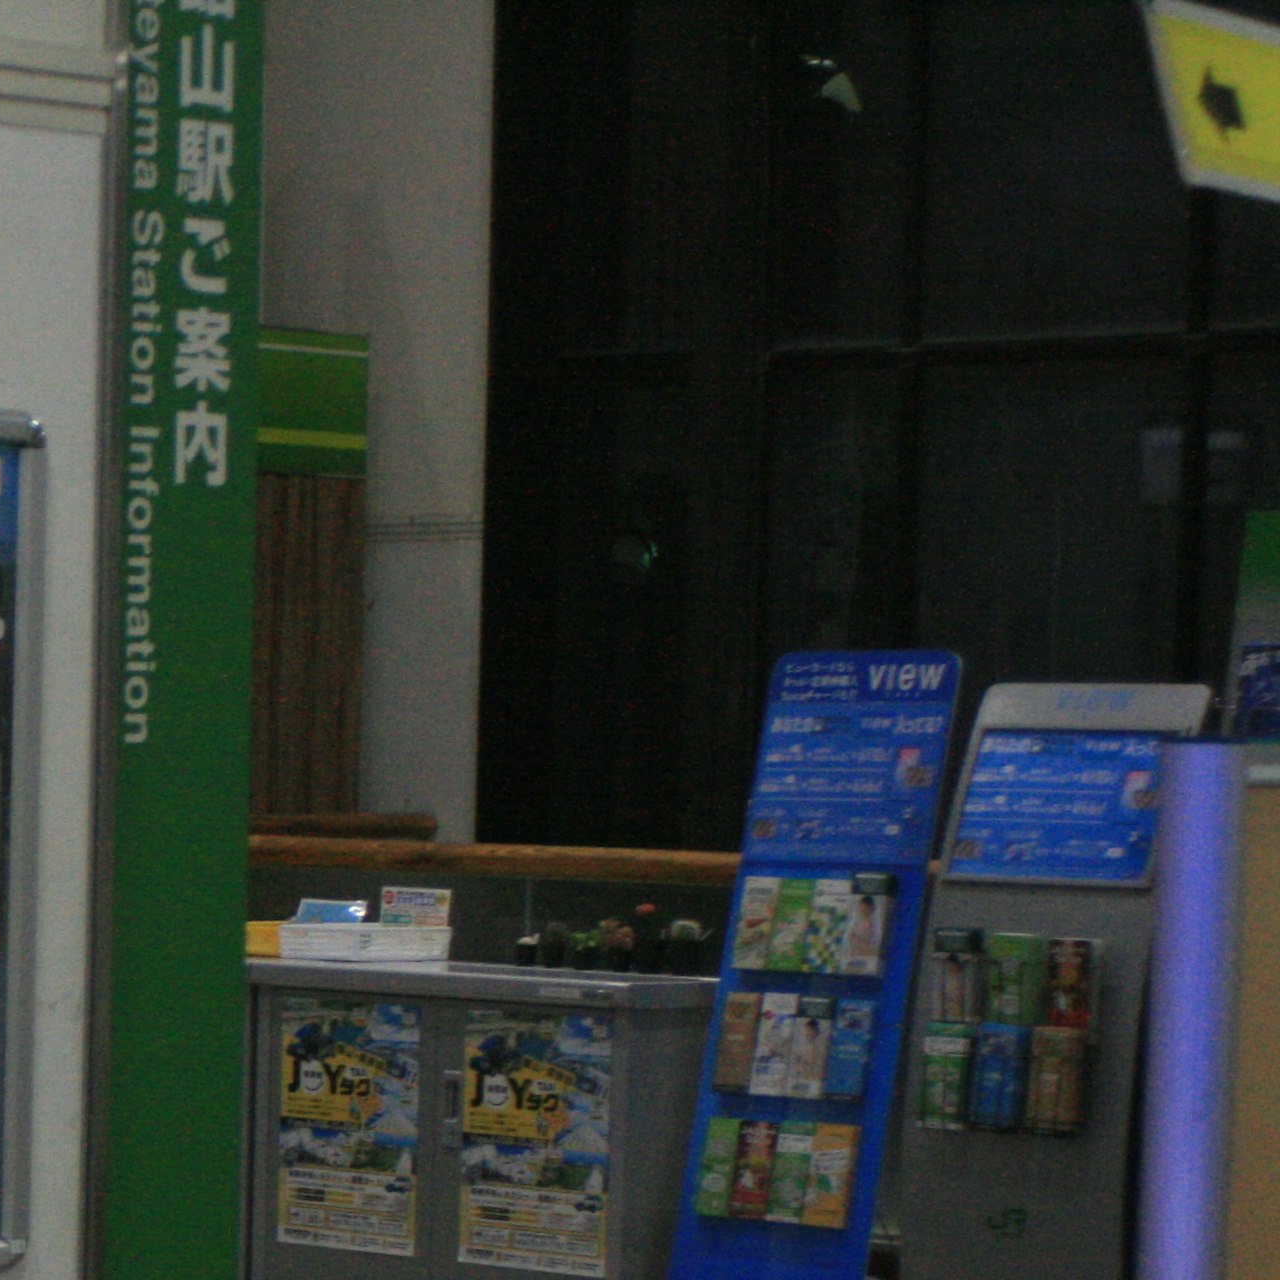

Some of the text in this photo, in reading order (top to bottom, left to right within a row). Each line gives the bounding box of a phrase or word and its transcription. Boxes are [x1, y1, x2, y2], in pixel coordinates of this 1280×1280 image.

[124, 0, 165, 744] eyama Station Information
[174, 0, 236, 485] 山駅ご案内
